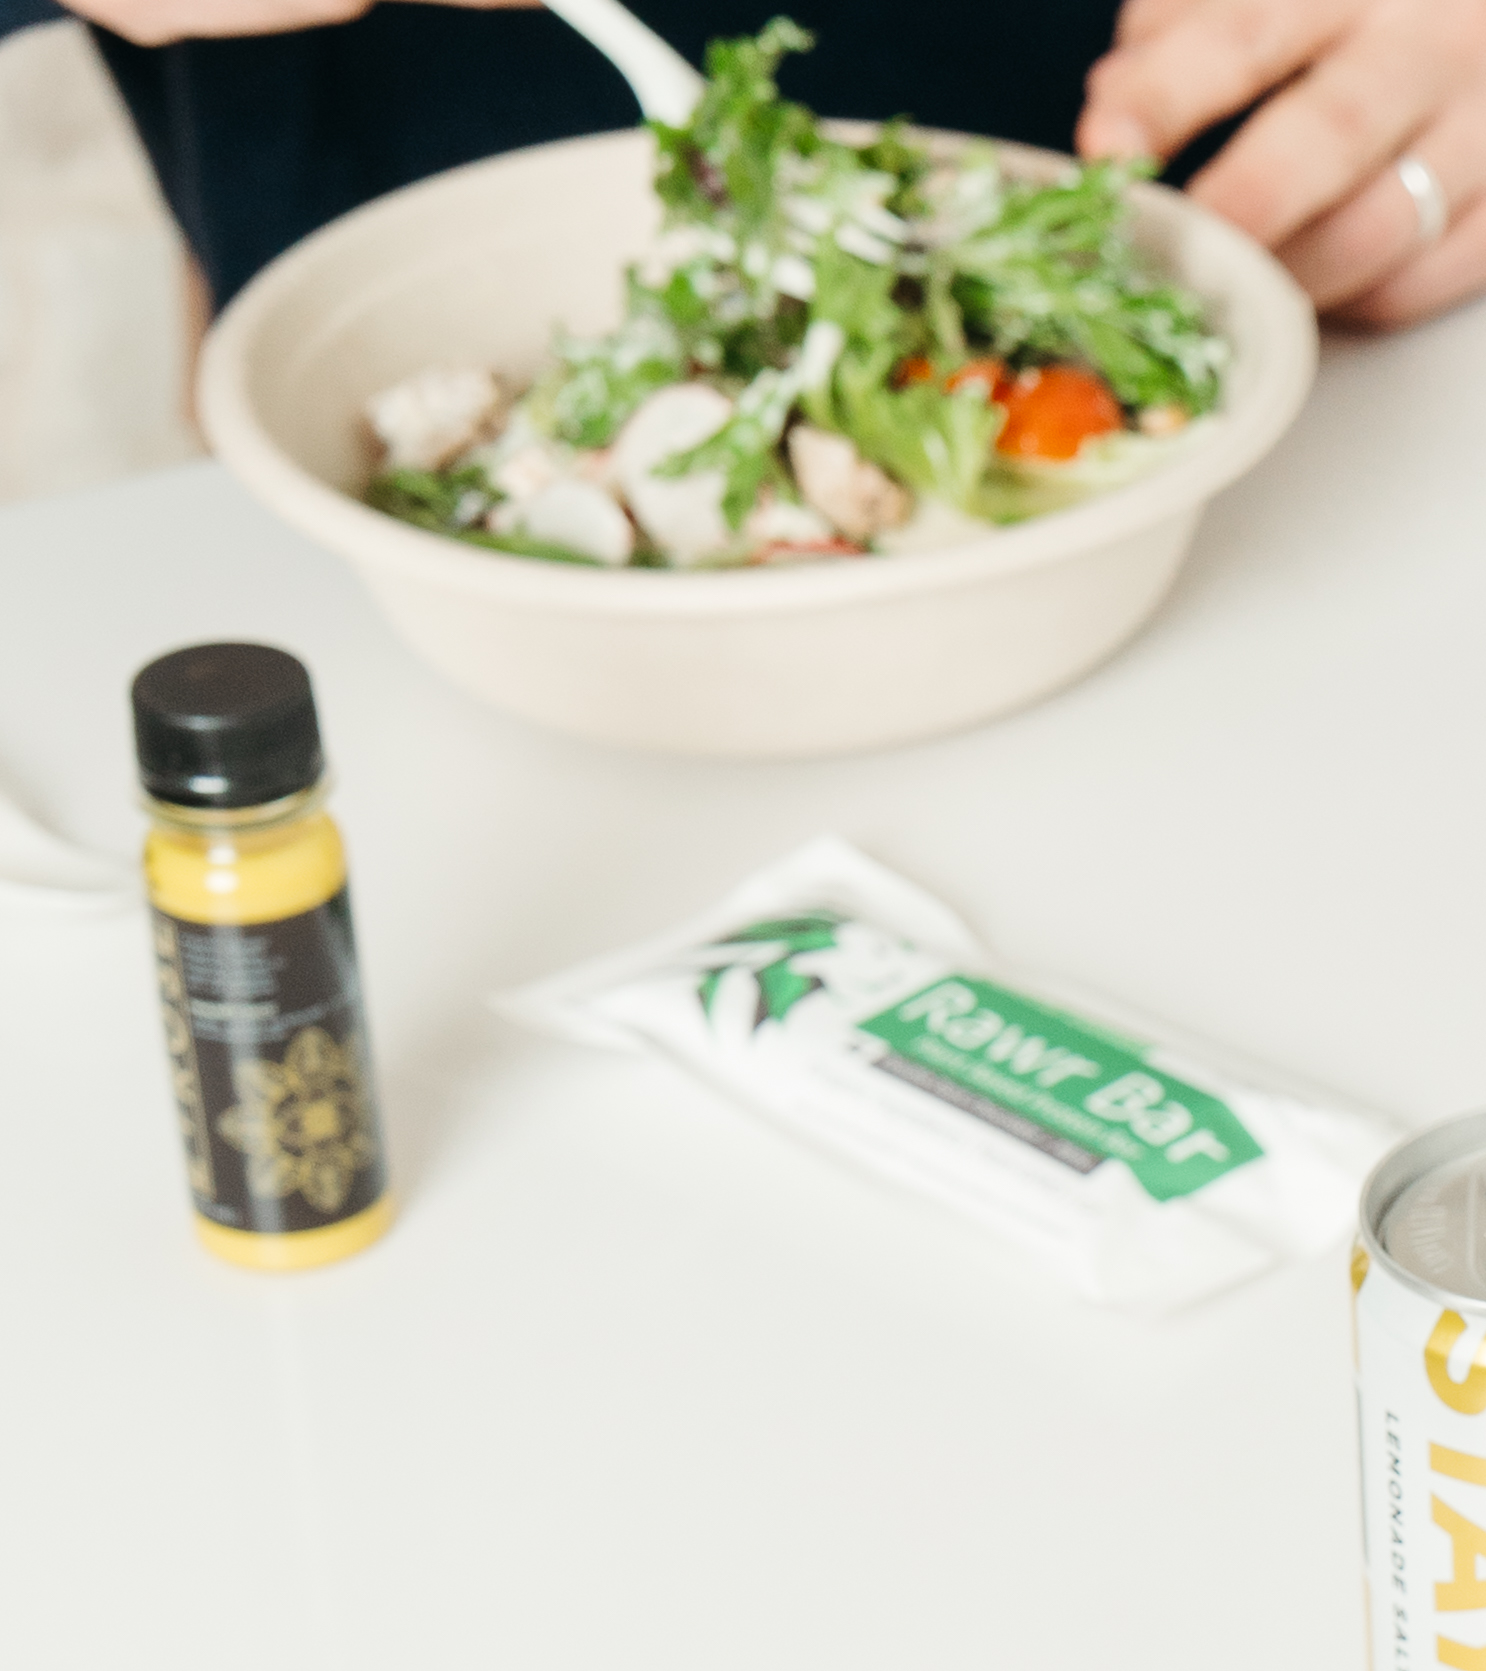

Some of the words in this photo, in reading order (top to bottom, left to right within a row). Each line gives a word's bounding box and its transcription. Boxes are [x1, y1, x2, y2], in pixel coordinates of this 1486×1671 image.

[899, 980, 1100, 1089] Rawr
[1084, 1070, 1231, 1164] Bar
[1385, 1409, 1406, 1595] LEMONADE
